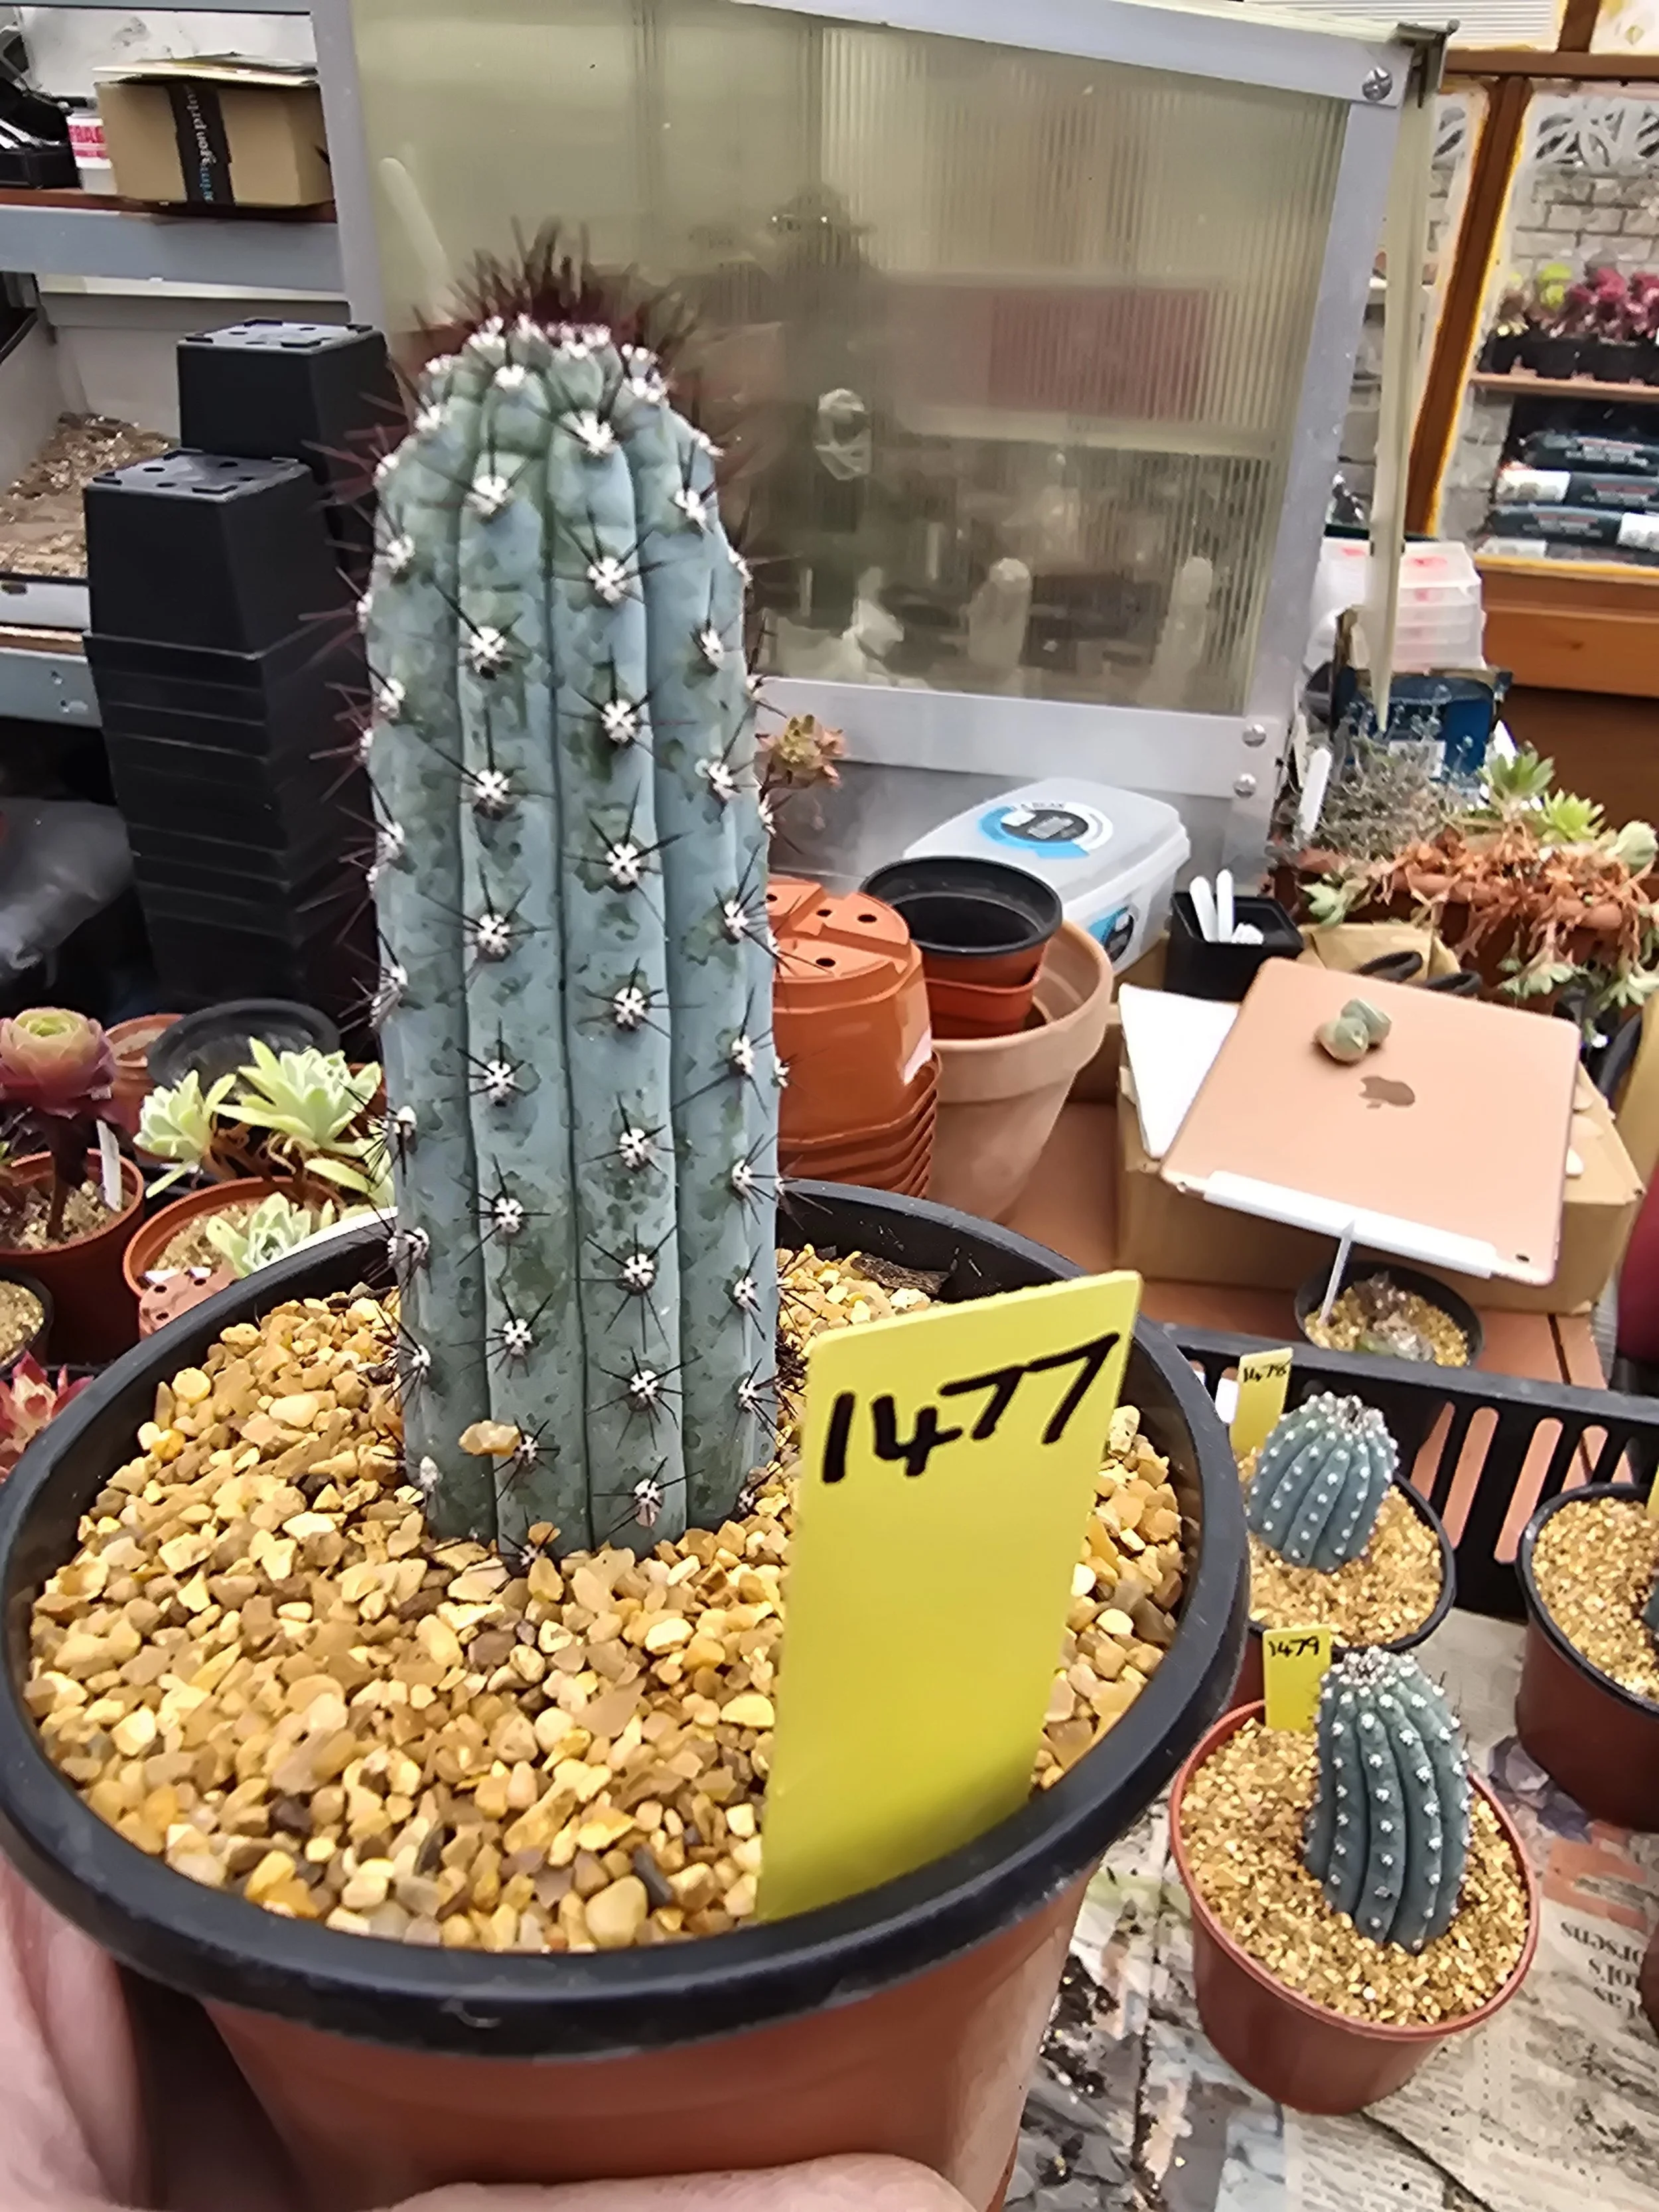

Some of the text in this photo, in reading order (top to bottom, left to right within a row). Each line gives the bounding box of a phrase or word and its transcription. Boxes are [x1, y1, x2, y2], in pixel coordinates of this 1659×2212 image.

[1244, 1361, 1289, 1382] 1478
[822, 1332, 1120, 1483] 1477
[1268, 1635, 1319, 1657] 1479
